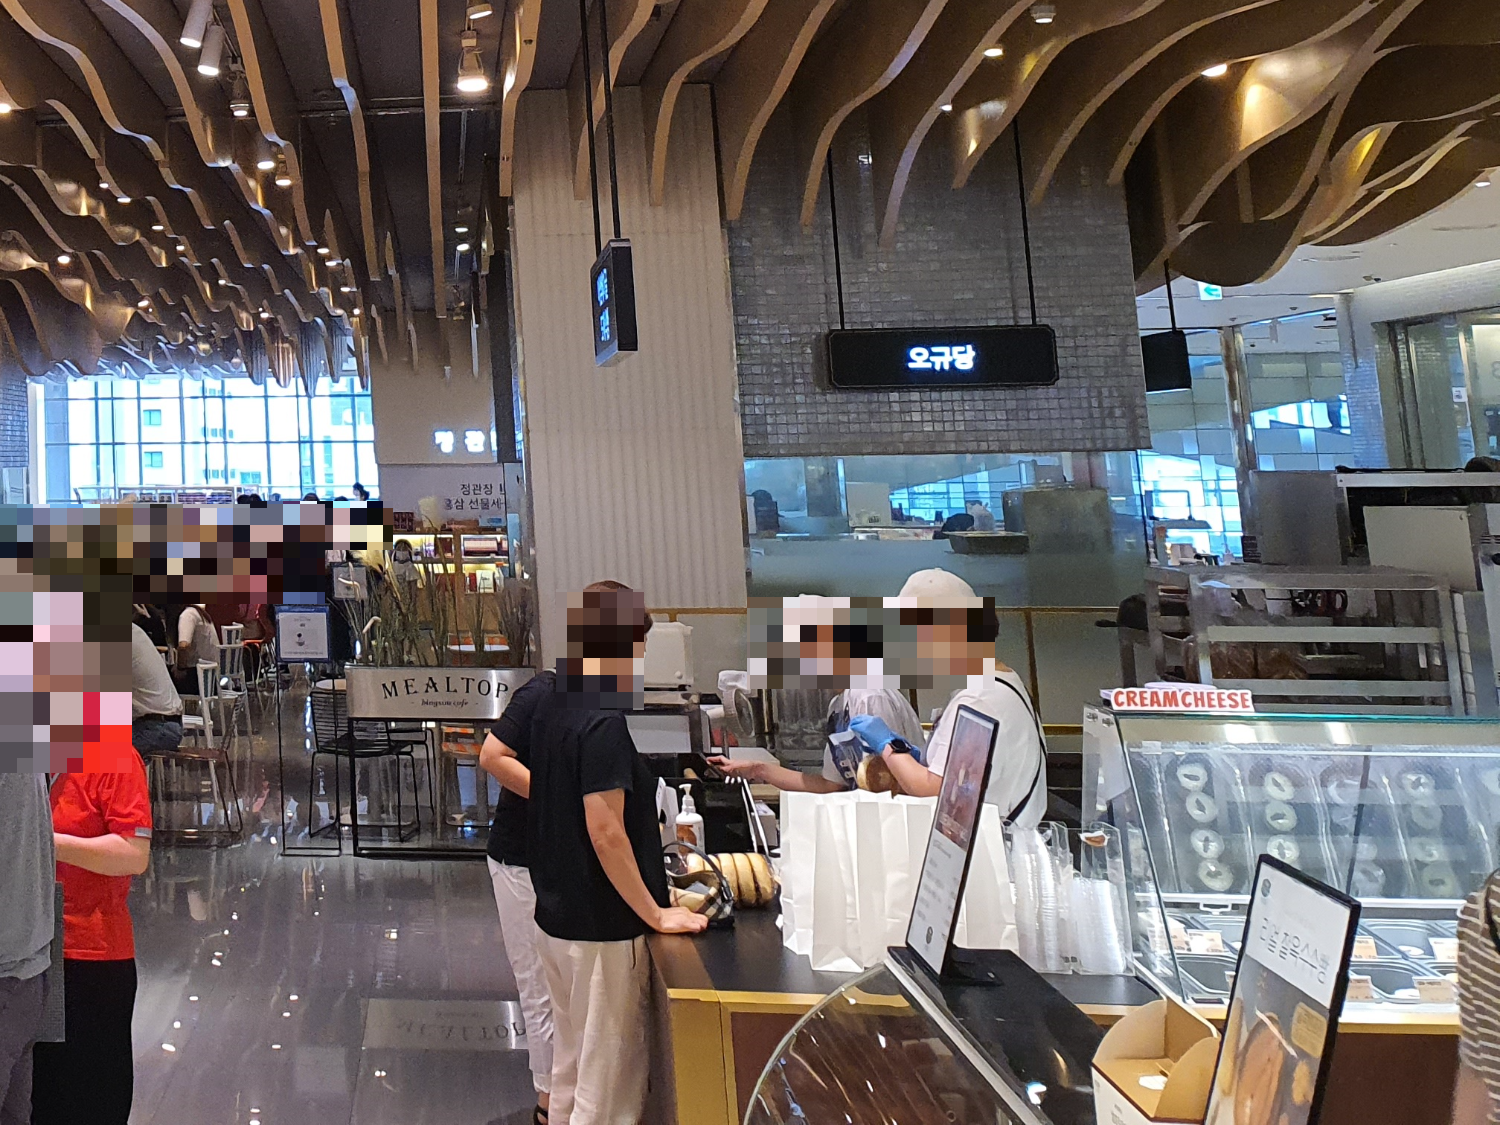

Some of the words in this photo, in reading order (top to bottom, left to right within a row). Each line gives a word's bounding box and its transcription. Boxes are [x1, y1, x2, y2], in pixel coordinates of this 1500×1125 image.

[908, 344, 975, 371] 오규당
[460, 483, 493, 496] 정관장
[382, 676, 509, 700] MEALTOP
